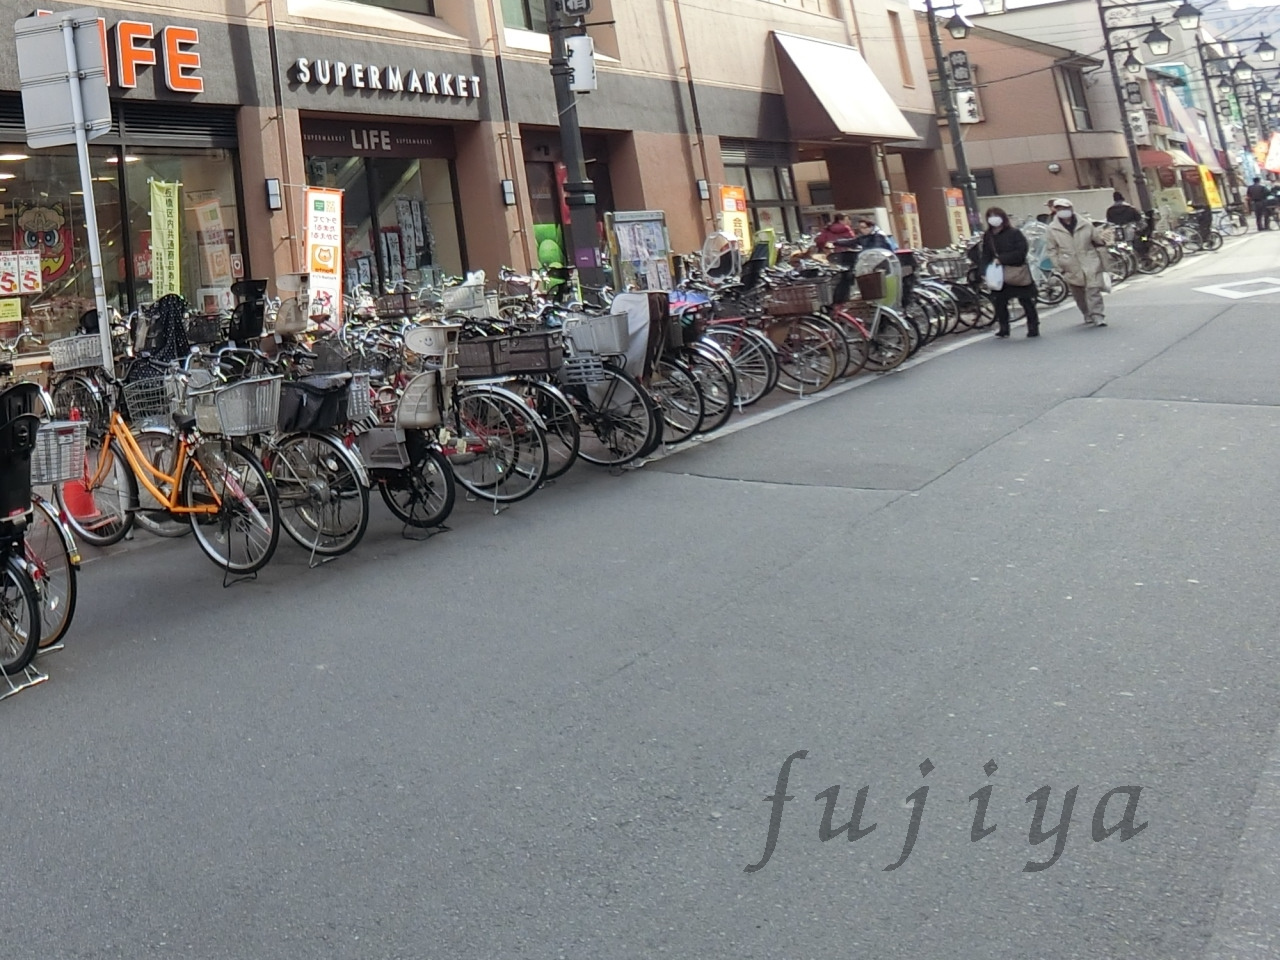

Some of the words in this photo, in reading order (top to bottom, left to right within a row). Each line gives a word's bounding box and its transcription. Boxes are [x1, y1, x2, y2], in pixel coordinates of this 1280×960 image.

[296, 57, 482, 99] SUPERMARKET
[303, 133, 346, 142] SUPERMARKET
[350, 129, 392, 151] LIFE
